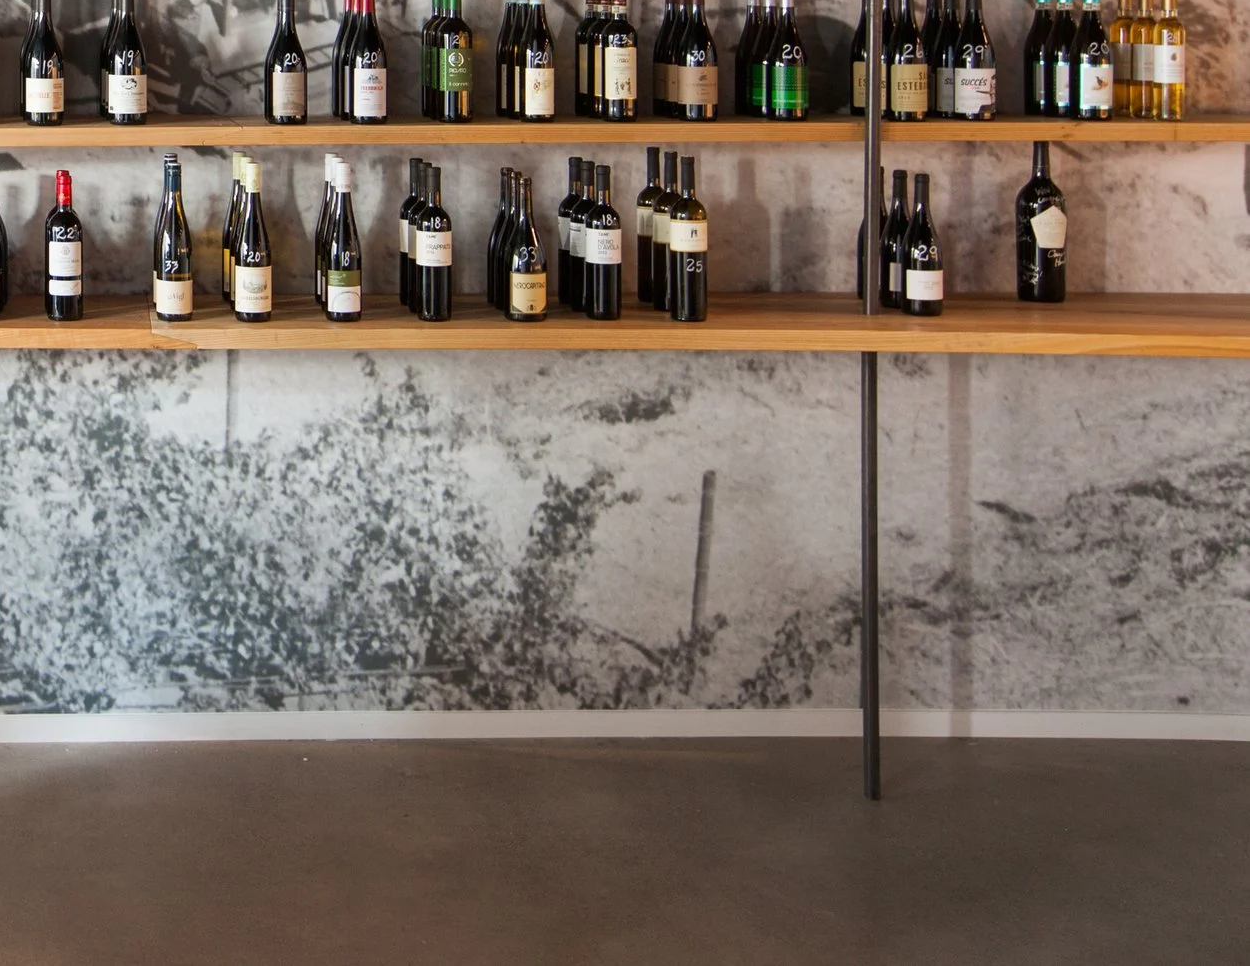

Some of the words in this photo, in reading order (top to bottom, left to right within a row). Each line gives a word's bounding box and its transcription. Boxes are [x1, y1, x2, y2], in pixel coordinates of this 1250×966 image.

[782, 44, 803, 60] 20
[962, 44, 985, 60] 29
[1089, 41, 1110, 56] 20
[121, 50, 134, 66] 19
[284, 52, 298, 67] 20
[363, 52, 378, 65] 20
[534, 52, 549, 65] 20
[691, 50, 706, 62] 30
[430, 216, 442, 230] 18
[602, 214, 613, 227] 18
[247, 252, 261, 263] 20
[341, 252, 350, 266] 18
[519, 246, 538, 263] 33
[917, 245, 938, 261] 29
[164, 260, 179, 273] 33
[686, 259, 703, 273] 25
